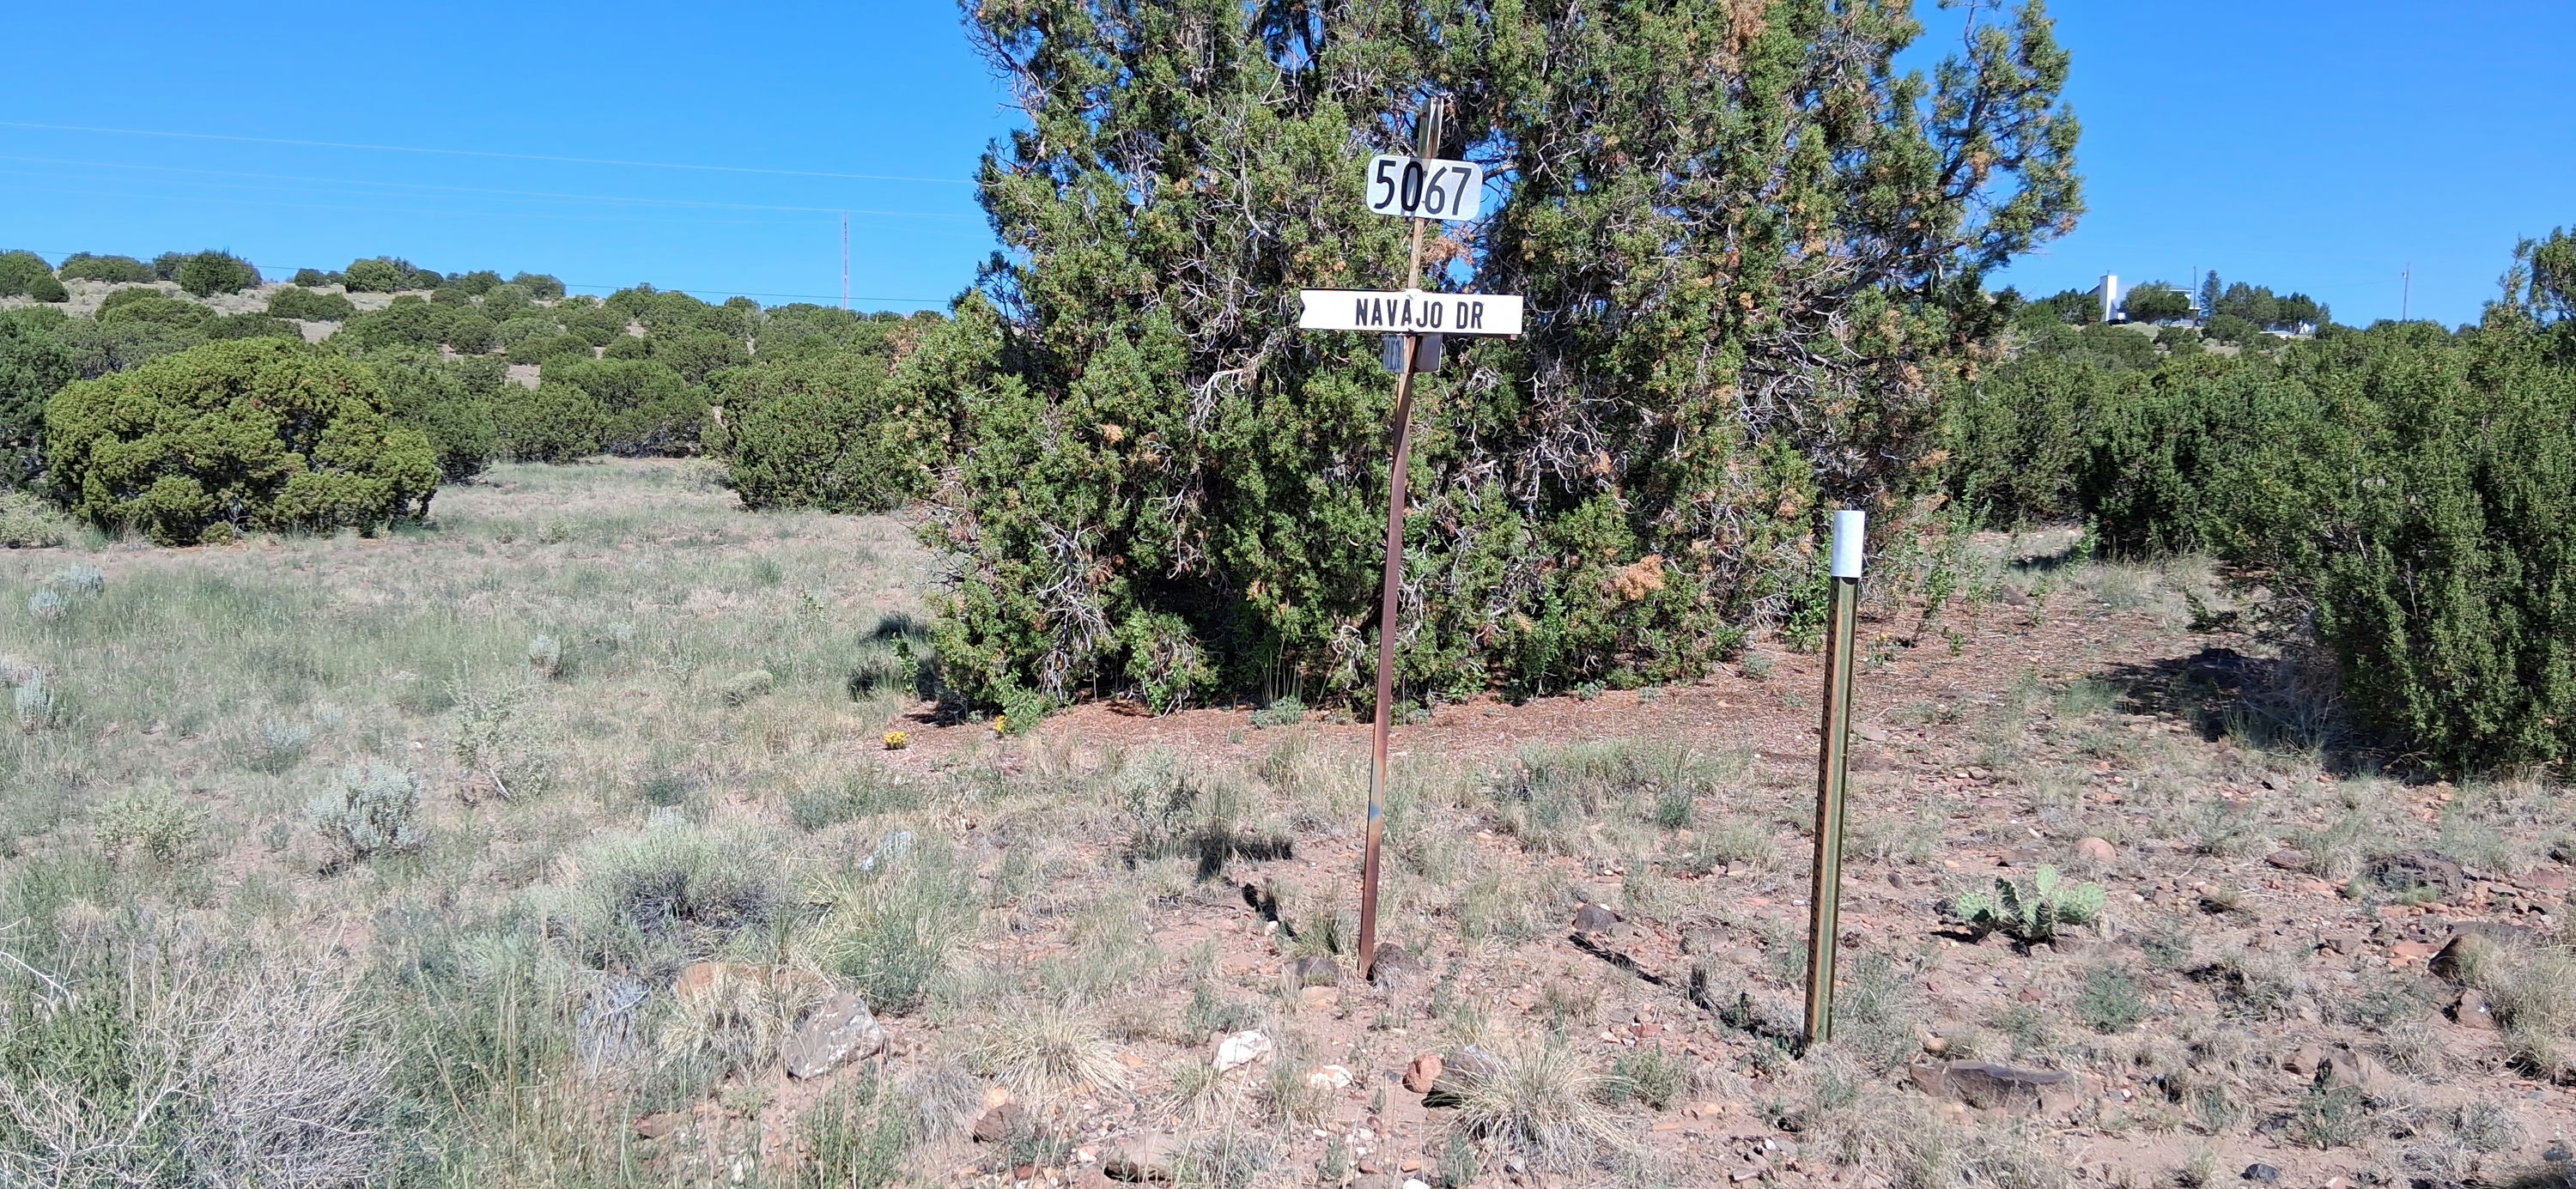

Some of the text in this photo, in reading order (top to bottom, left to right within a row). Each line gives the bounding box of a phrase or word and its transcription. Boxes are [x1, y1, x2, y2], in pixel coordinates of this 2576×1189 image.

[1374, 159, 1472, 215] 5067
[1356, 298, 1483, 329] NAVAJO DR
